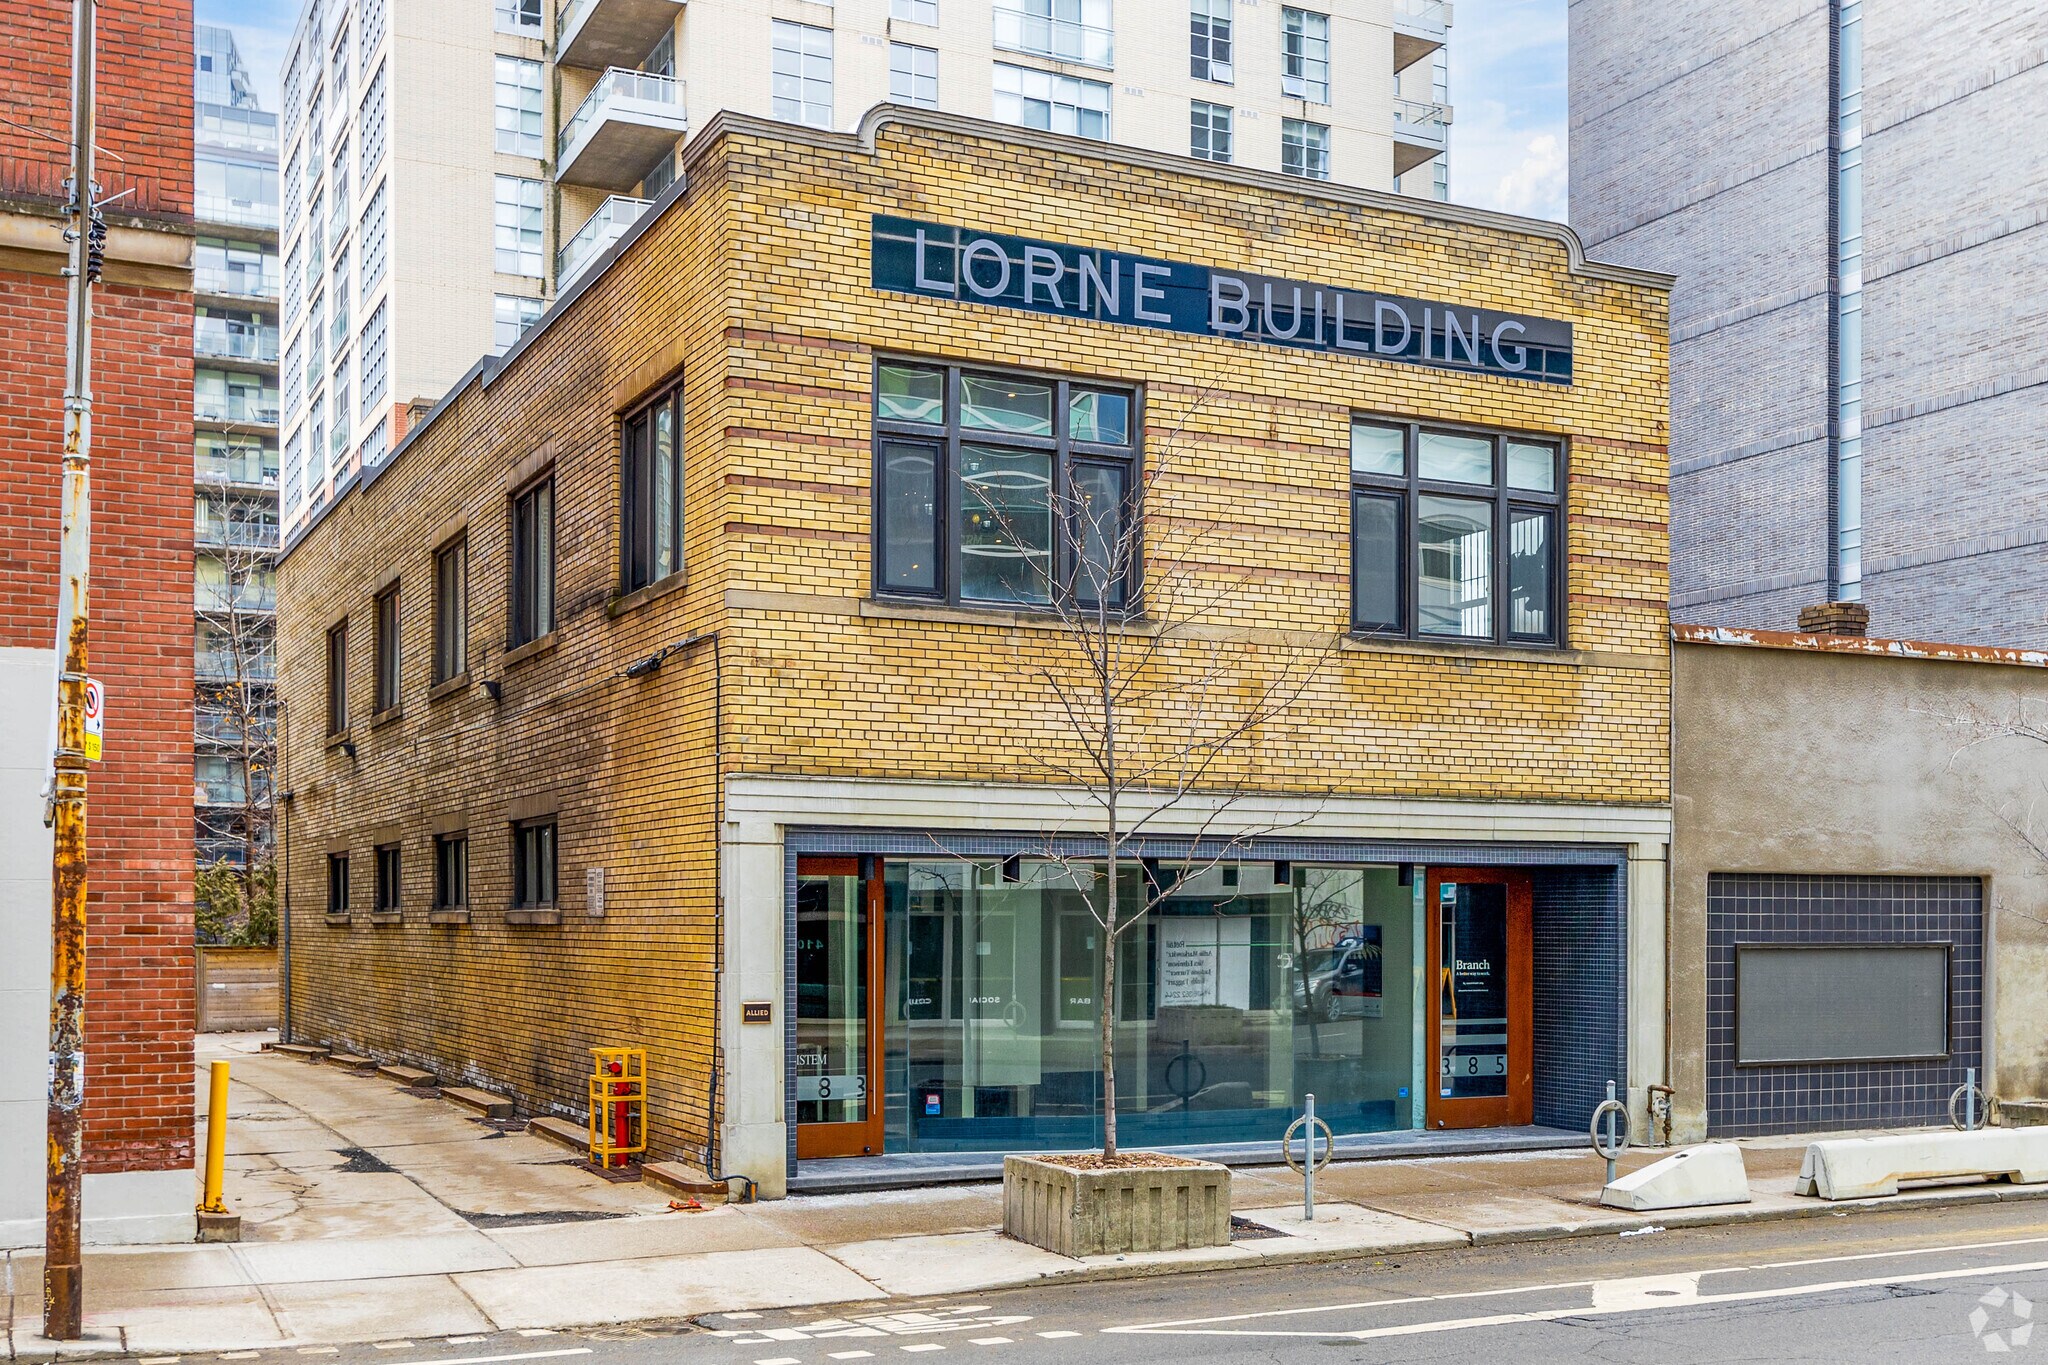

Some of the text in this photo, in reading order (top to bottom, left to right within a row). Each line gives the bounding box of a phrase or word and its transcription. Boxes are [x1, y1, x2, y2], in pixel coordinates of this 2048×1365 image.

[915, 228, 1528, 371] LORNE BUILDING
[1456, 959, 1490, 970] Branch
[746, 1009, 769, 1017] ALLIED
